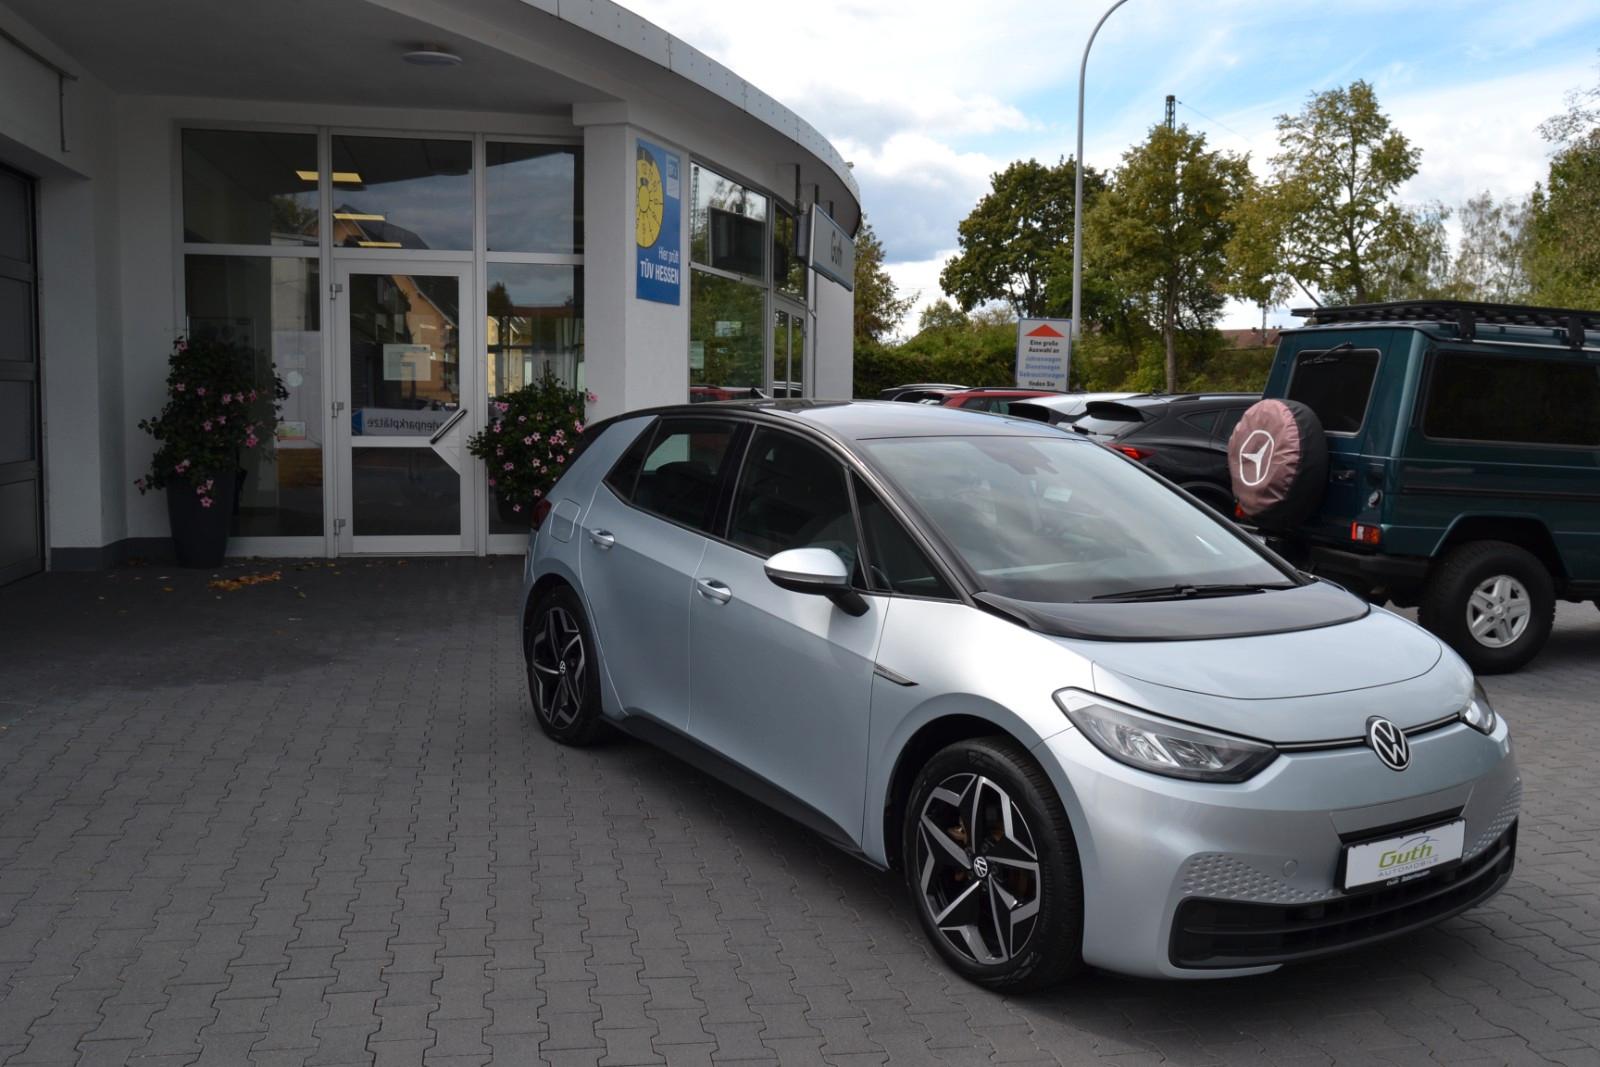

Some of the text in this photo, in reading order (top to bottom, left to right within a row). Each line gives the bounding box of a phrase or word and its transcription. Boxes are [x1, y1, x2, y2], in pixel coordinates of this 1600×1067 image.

[658, 246, 669, 261] Hier
[640, 258, 679, 285] TÜV HESSEN
[1378, 843, 1433, 868] Guth
[1377, 857, 1439, 878] AUTOMOBILE
